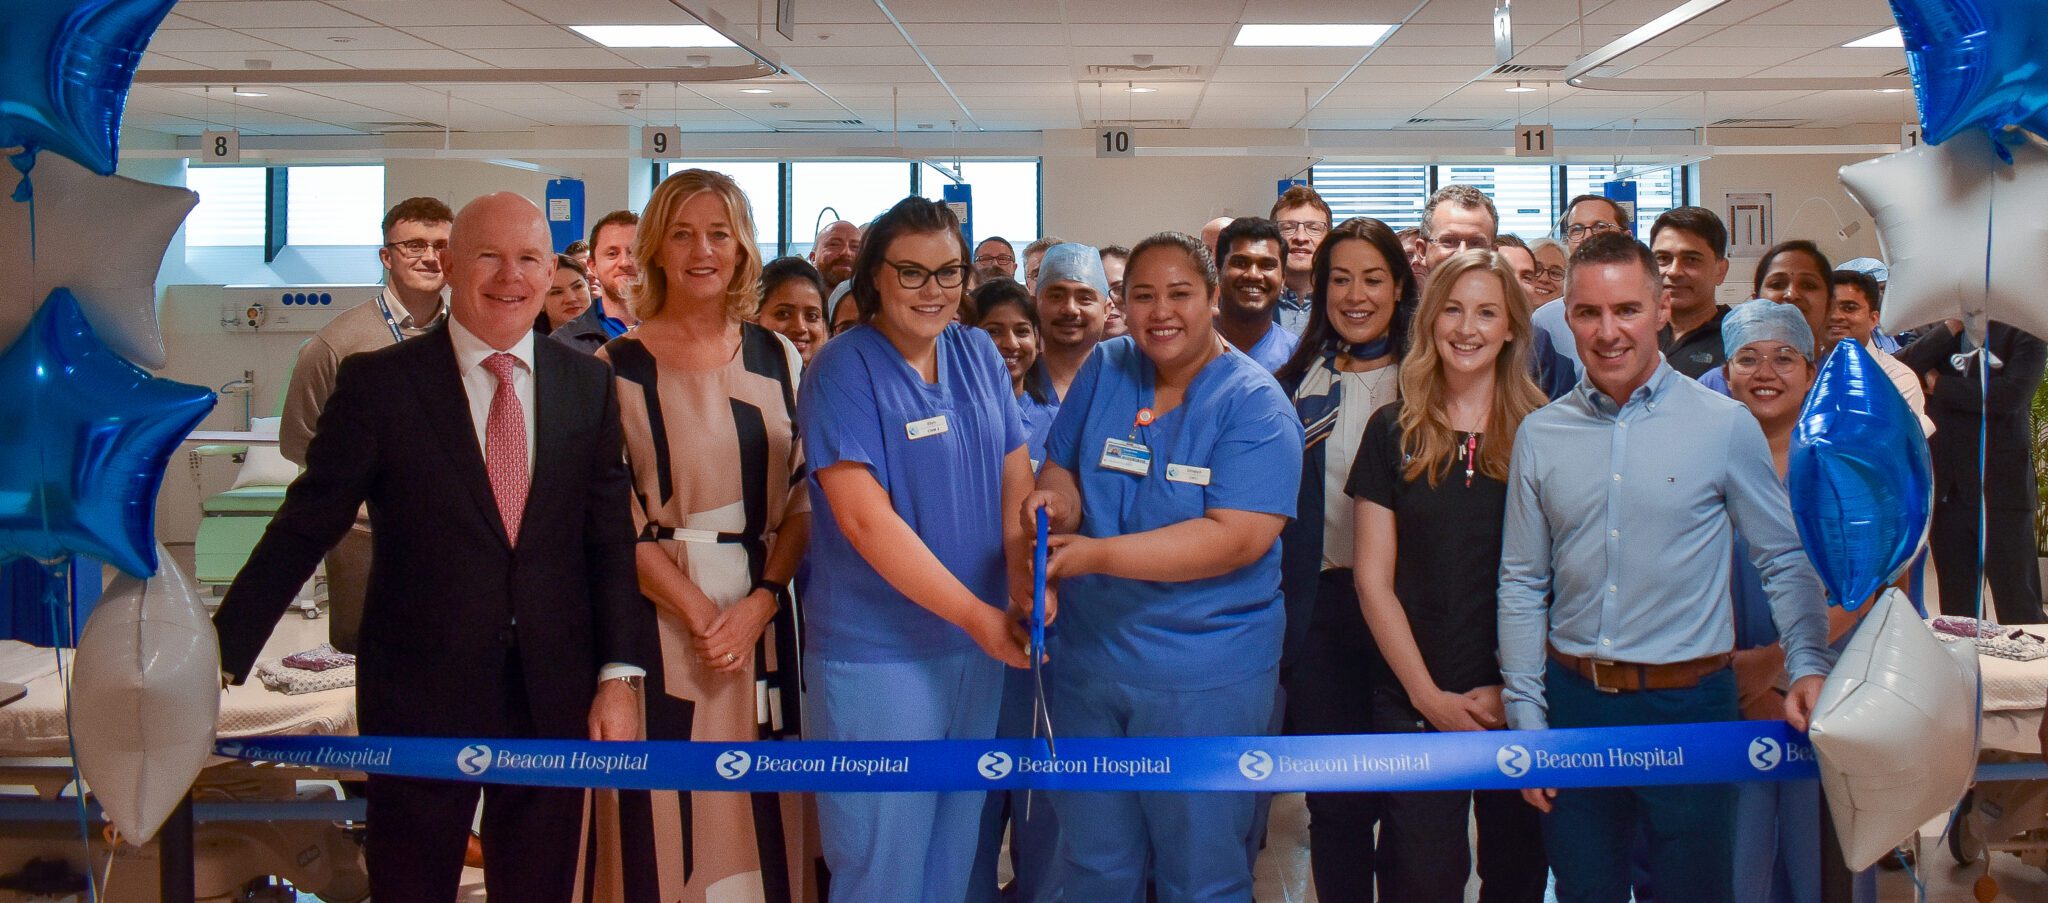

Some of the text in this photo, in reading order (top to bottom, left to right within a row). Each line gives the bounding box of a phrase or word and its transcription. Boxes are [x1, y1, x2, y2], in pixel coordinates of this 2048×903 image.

[215, 136, 228, 157] 8
[653, 132, 668, 154] 9
[1102, 131, 1129, 152] 10
[1522, 130, 1545, 151] 11
[314, 746, 393, 768] Hospital
[496, 749, 649, 774] Beacon Hospital
[1535, 746, 1685, 771] Beacon Hospital
[1785, 742, 1819, 762] Bea
[755, 755, 909, 776] Beacon Hospital
[1017, 756, 1172, 777] Beacon Hospital
[1278, 752, 1431, 775] Beacon Hospital
